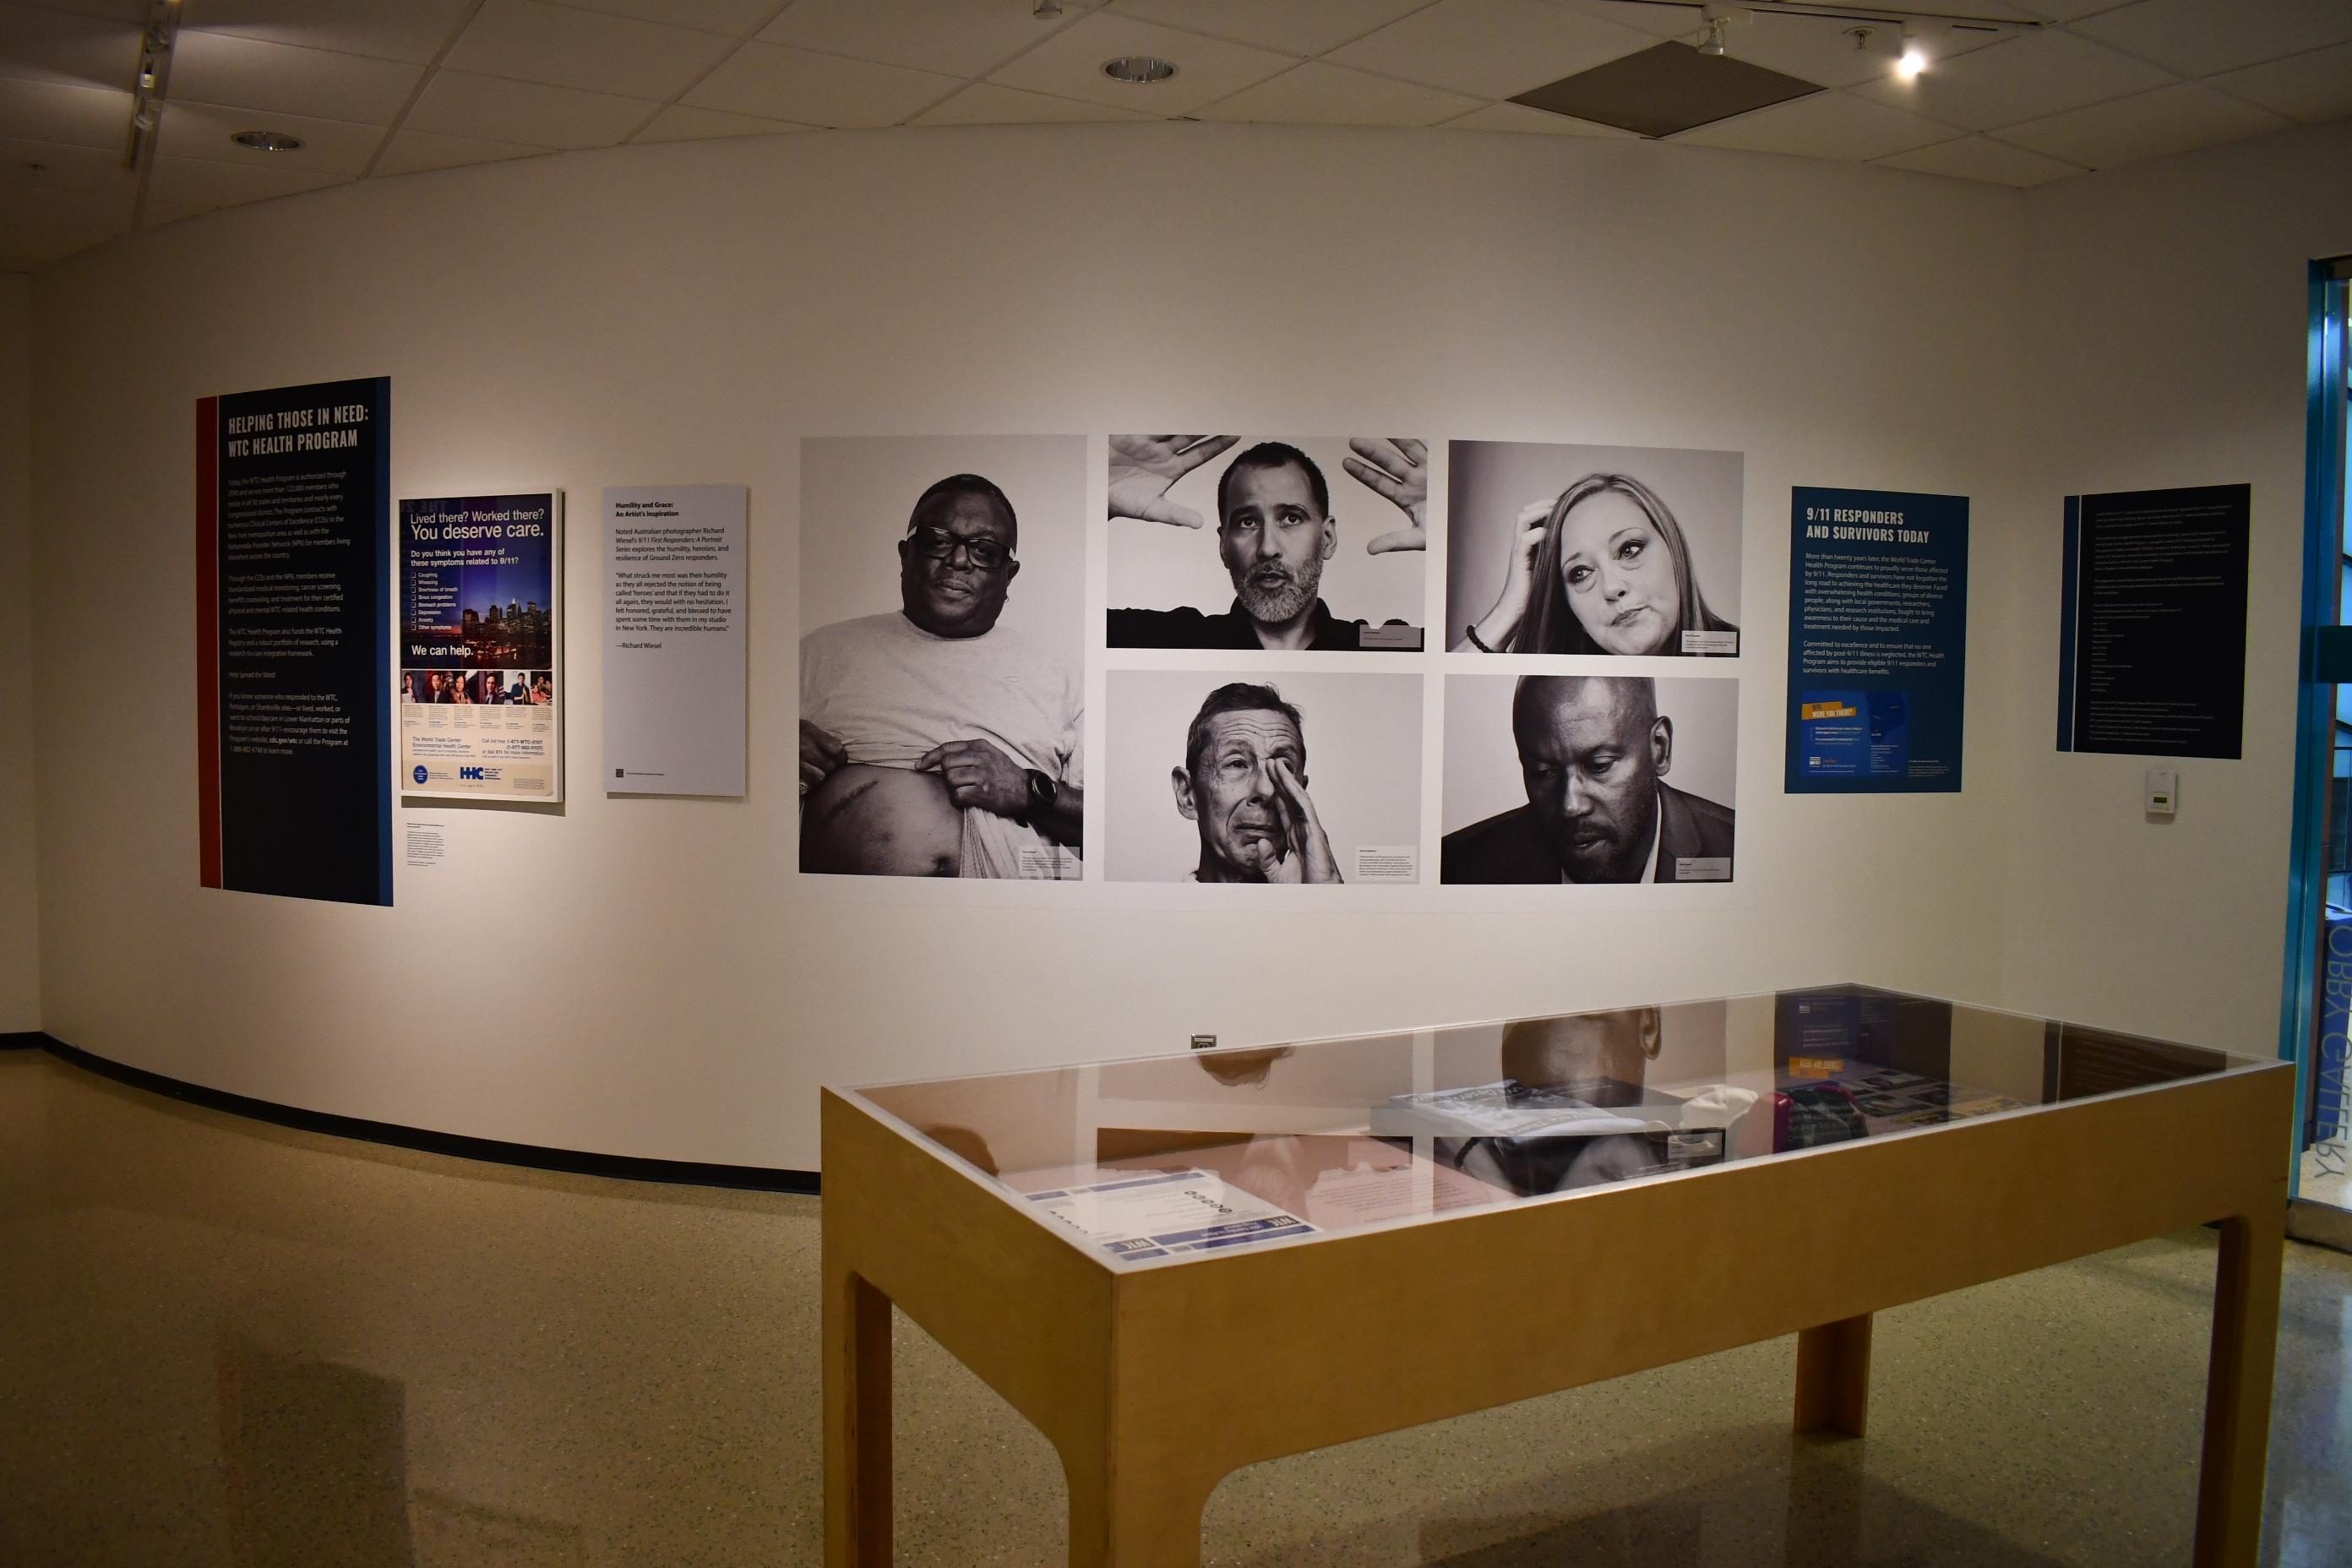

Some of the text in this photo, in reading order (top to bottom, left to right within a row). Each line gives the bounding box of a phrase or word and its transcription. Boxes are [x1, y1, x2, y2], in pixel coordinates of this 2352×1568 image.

[229, 404, 368, 435] HELPING THOSE IN NEED:
[229, 429, 357, 458] WTC HEALTH PROGRAM
[411, 508, 544, 525] Lived there? Worked there?
[1807, 508, 1903, 525] 9/11 RESPONDERS
[411, 523, 544, 541] You deserve care.
[1806, 525, 1930, 544] AND SURVIVORS TODAY
[430, 559, 464, 567] symptoms
[1834, 554, 1852, 562] twenty
[1824, 562, 1847, 571] Program
[1880, 564, 1899, 573] proudly
[411, 645, 473, 658] We can help.
[321, 738, 342, 747] Program
[460, 767, 484, 780] HHC
